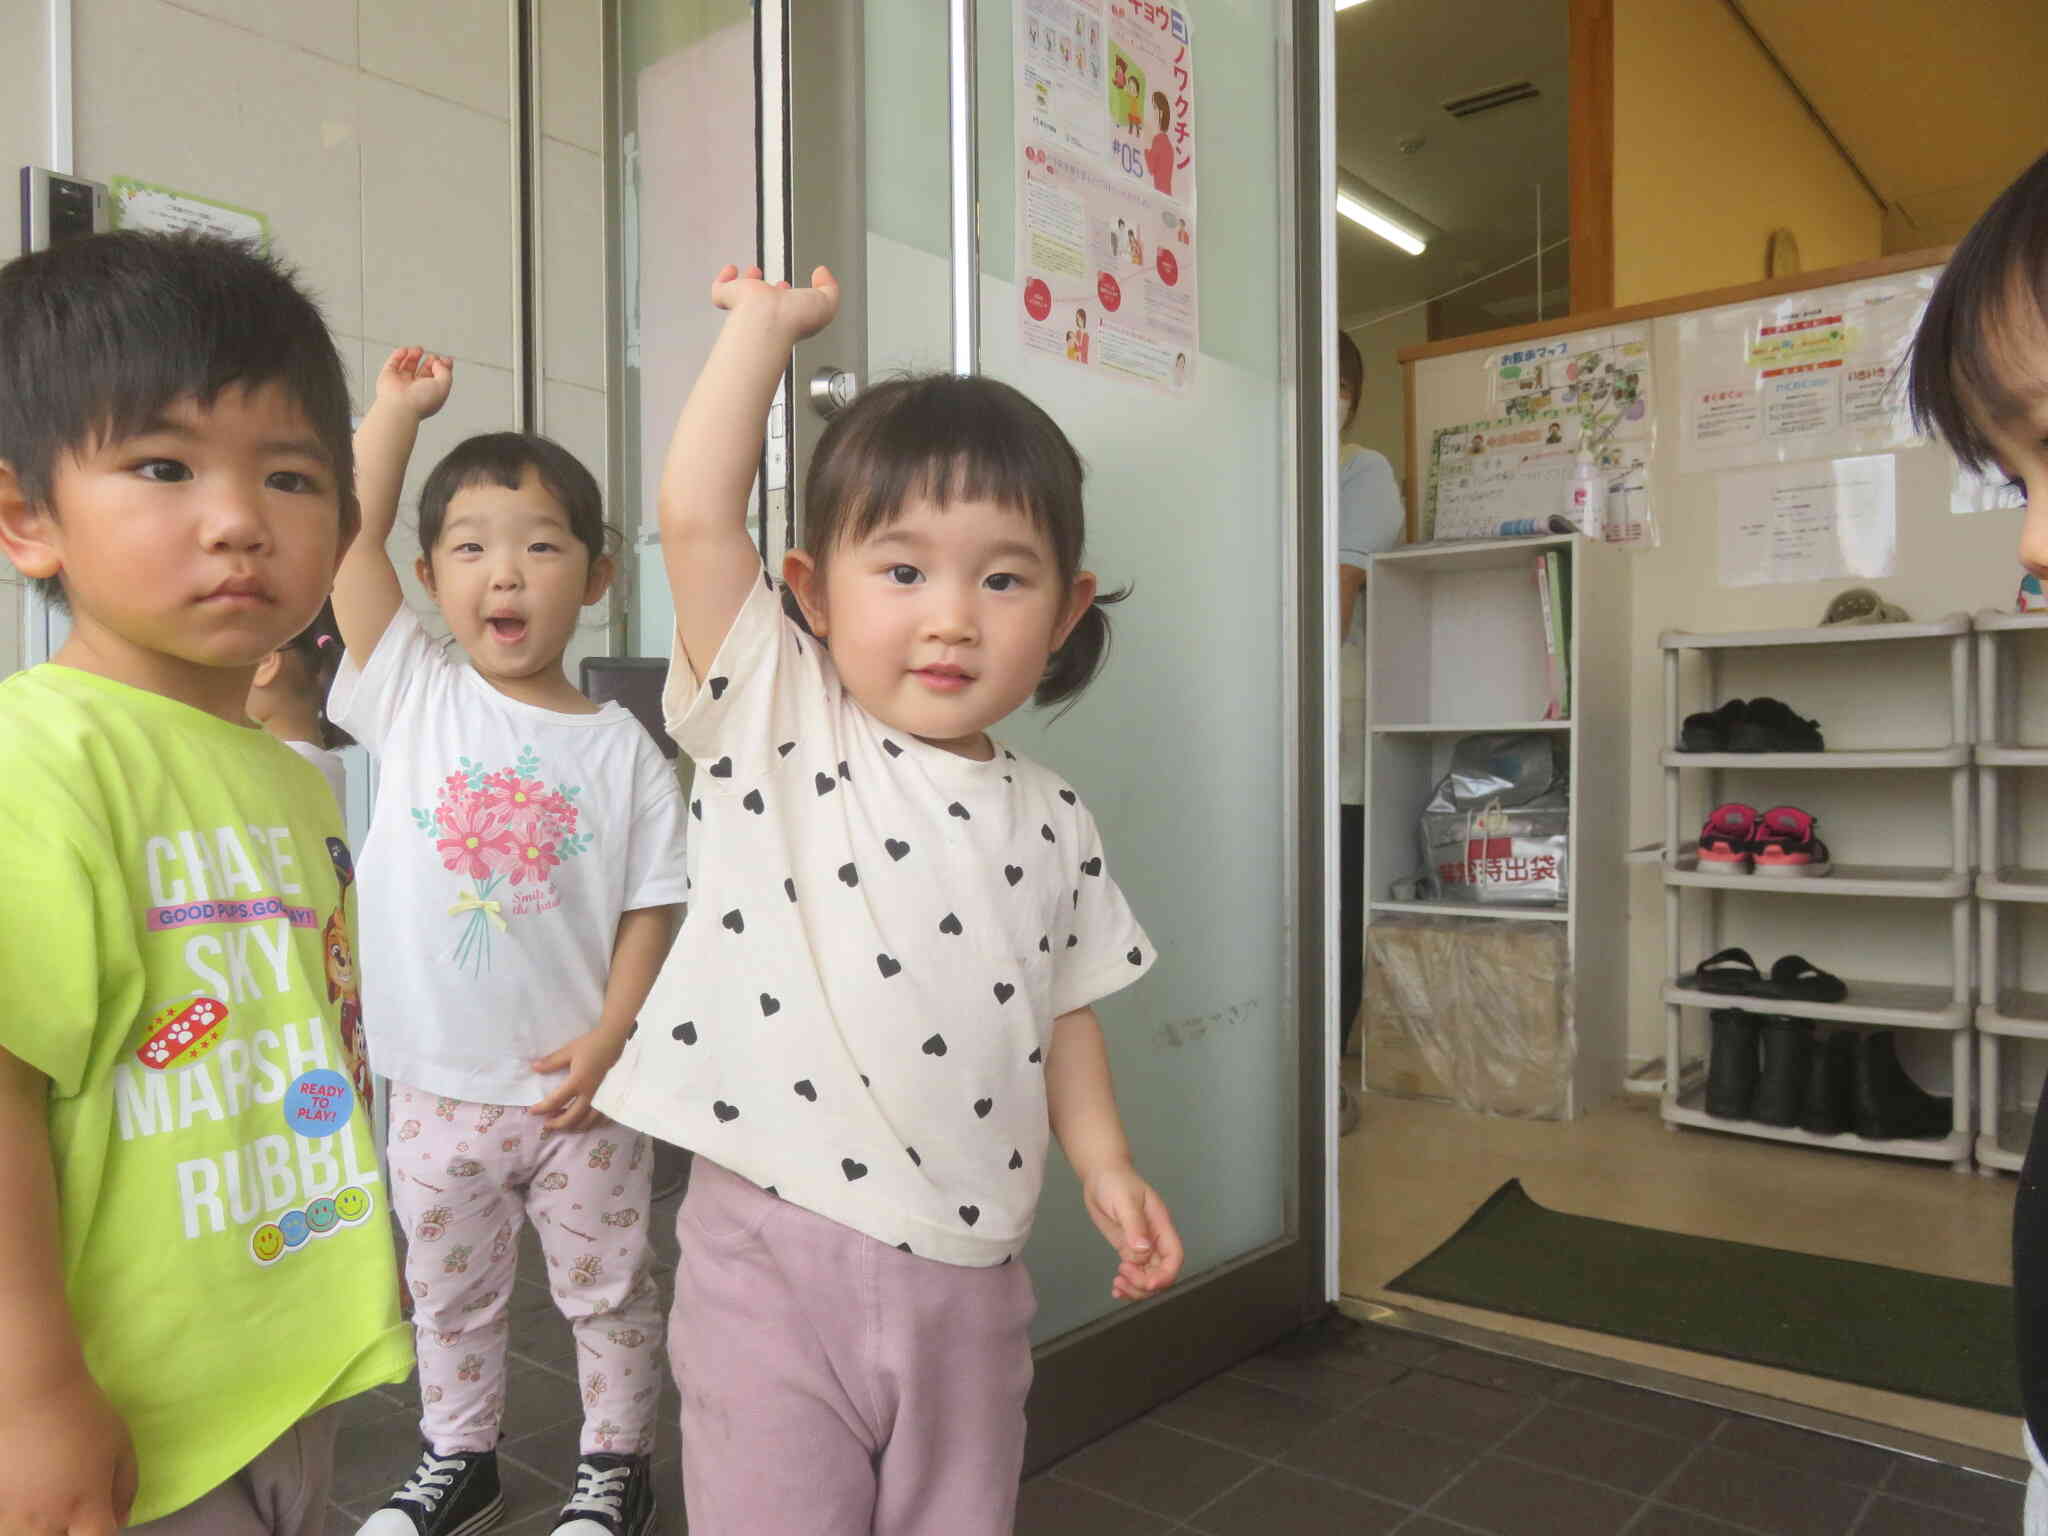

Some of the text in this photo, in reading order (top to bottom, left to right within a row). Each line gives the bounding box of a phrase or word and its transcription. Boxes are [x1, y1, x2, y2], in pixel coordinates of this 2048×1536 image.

[1112, 139, 1144, 178] #05
[160, 904, 215, 925] GOOD
[184, 918, 291, 1004] SKY
[300, 1082, 345, 1097] READY
[311, 1096, 329, 1109] TO
[297, 1107, 337, 1122] PLAY!
